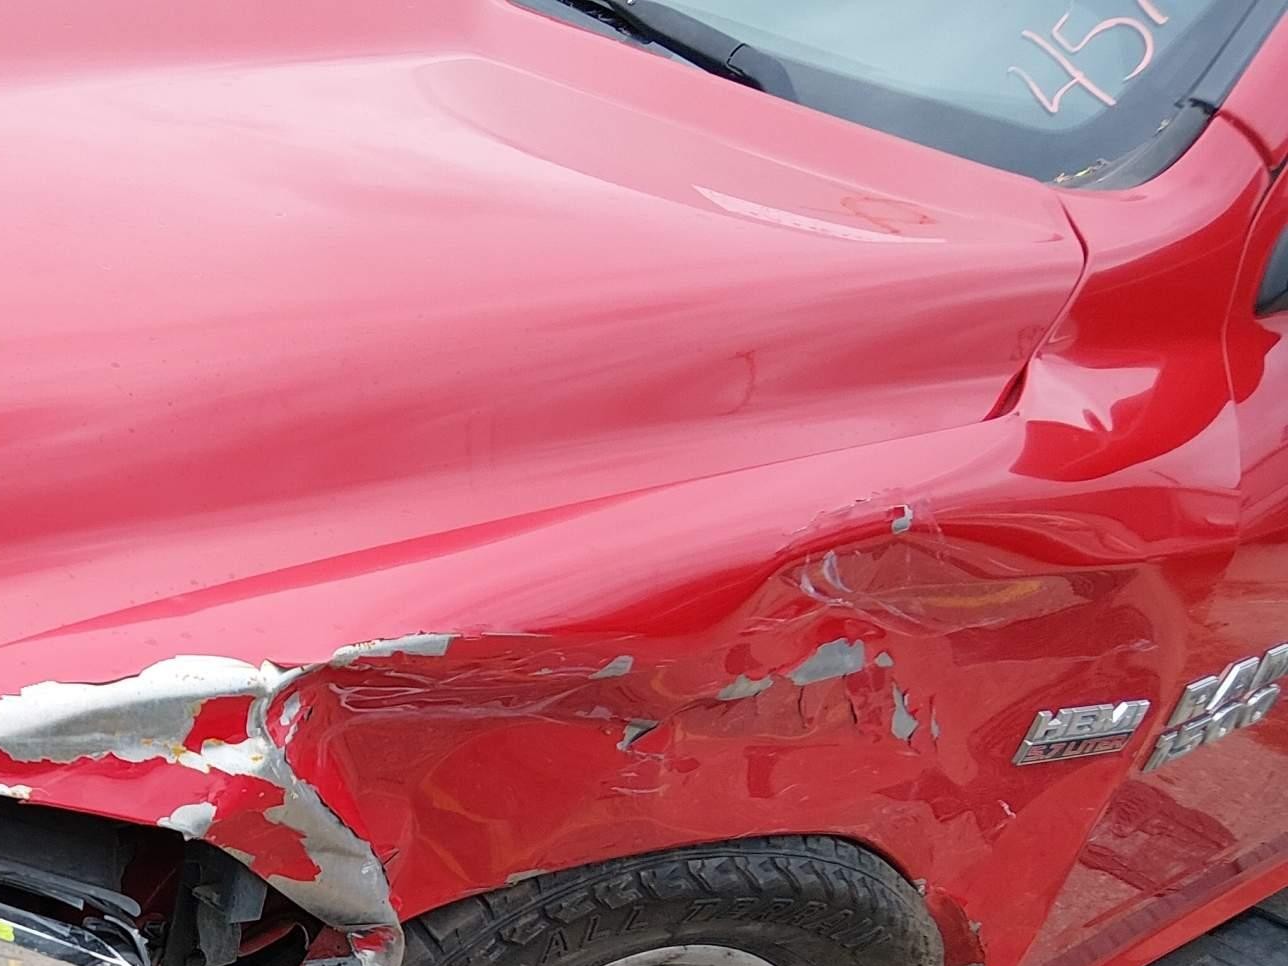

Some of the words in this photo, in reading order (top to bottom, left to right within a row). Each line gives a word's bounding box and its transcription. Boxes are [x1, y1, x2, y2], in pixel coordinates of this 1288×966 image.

[1024, 699, 1151, 742] HEMI
[539, 907, 648, 966] ALL
[683, 897, 893, 950] TERRAIN
